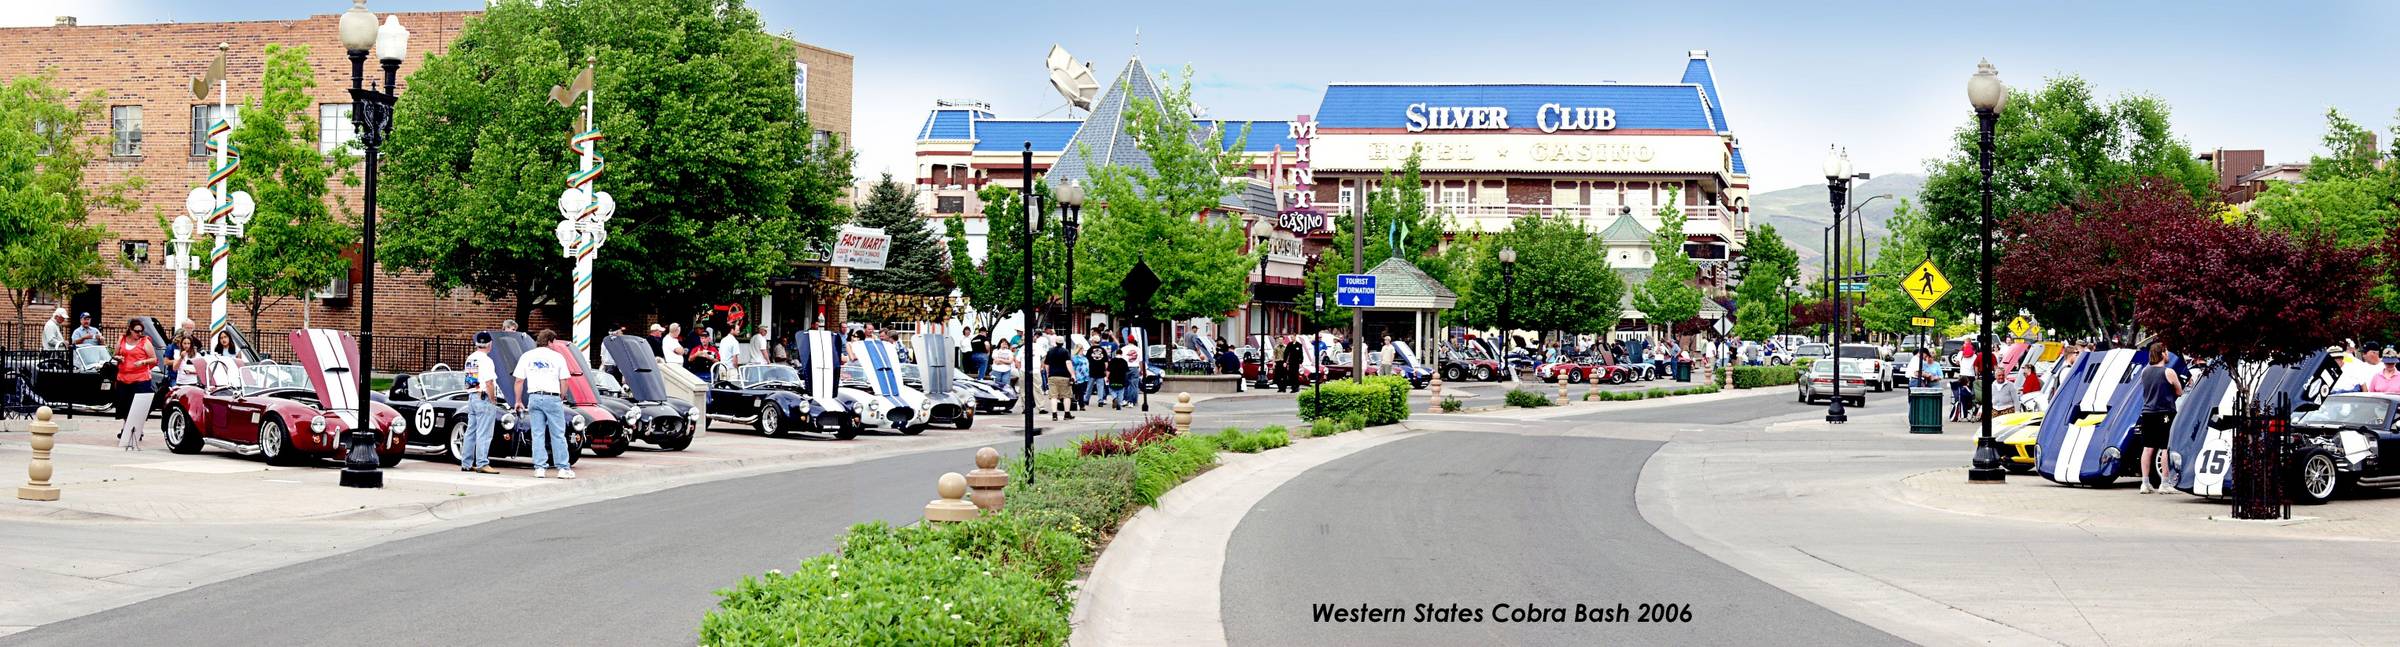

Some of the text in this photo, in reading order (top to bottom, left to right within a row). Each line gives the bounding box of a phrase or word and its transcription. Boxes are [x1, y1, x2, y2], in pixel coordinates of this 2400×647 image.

[1406, 102, 1617, 133] SILVER CLUB
[1369, 142, 1655, 163] HOTEL CASINO
[1287, 121, 1319, 208] MINT
[1280, 211, 1323, 234] CASINO
[840, 234, 862, 248] FAST
[860, 237, 885, 250] MART
[1345, 277, 1369, 285] TOURIST
[418, 409, 431, 429] 15
[2200, 450, 2228, 474] 15
